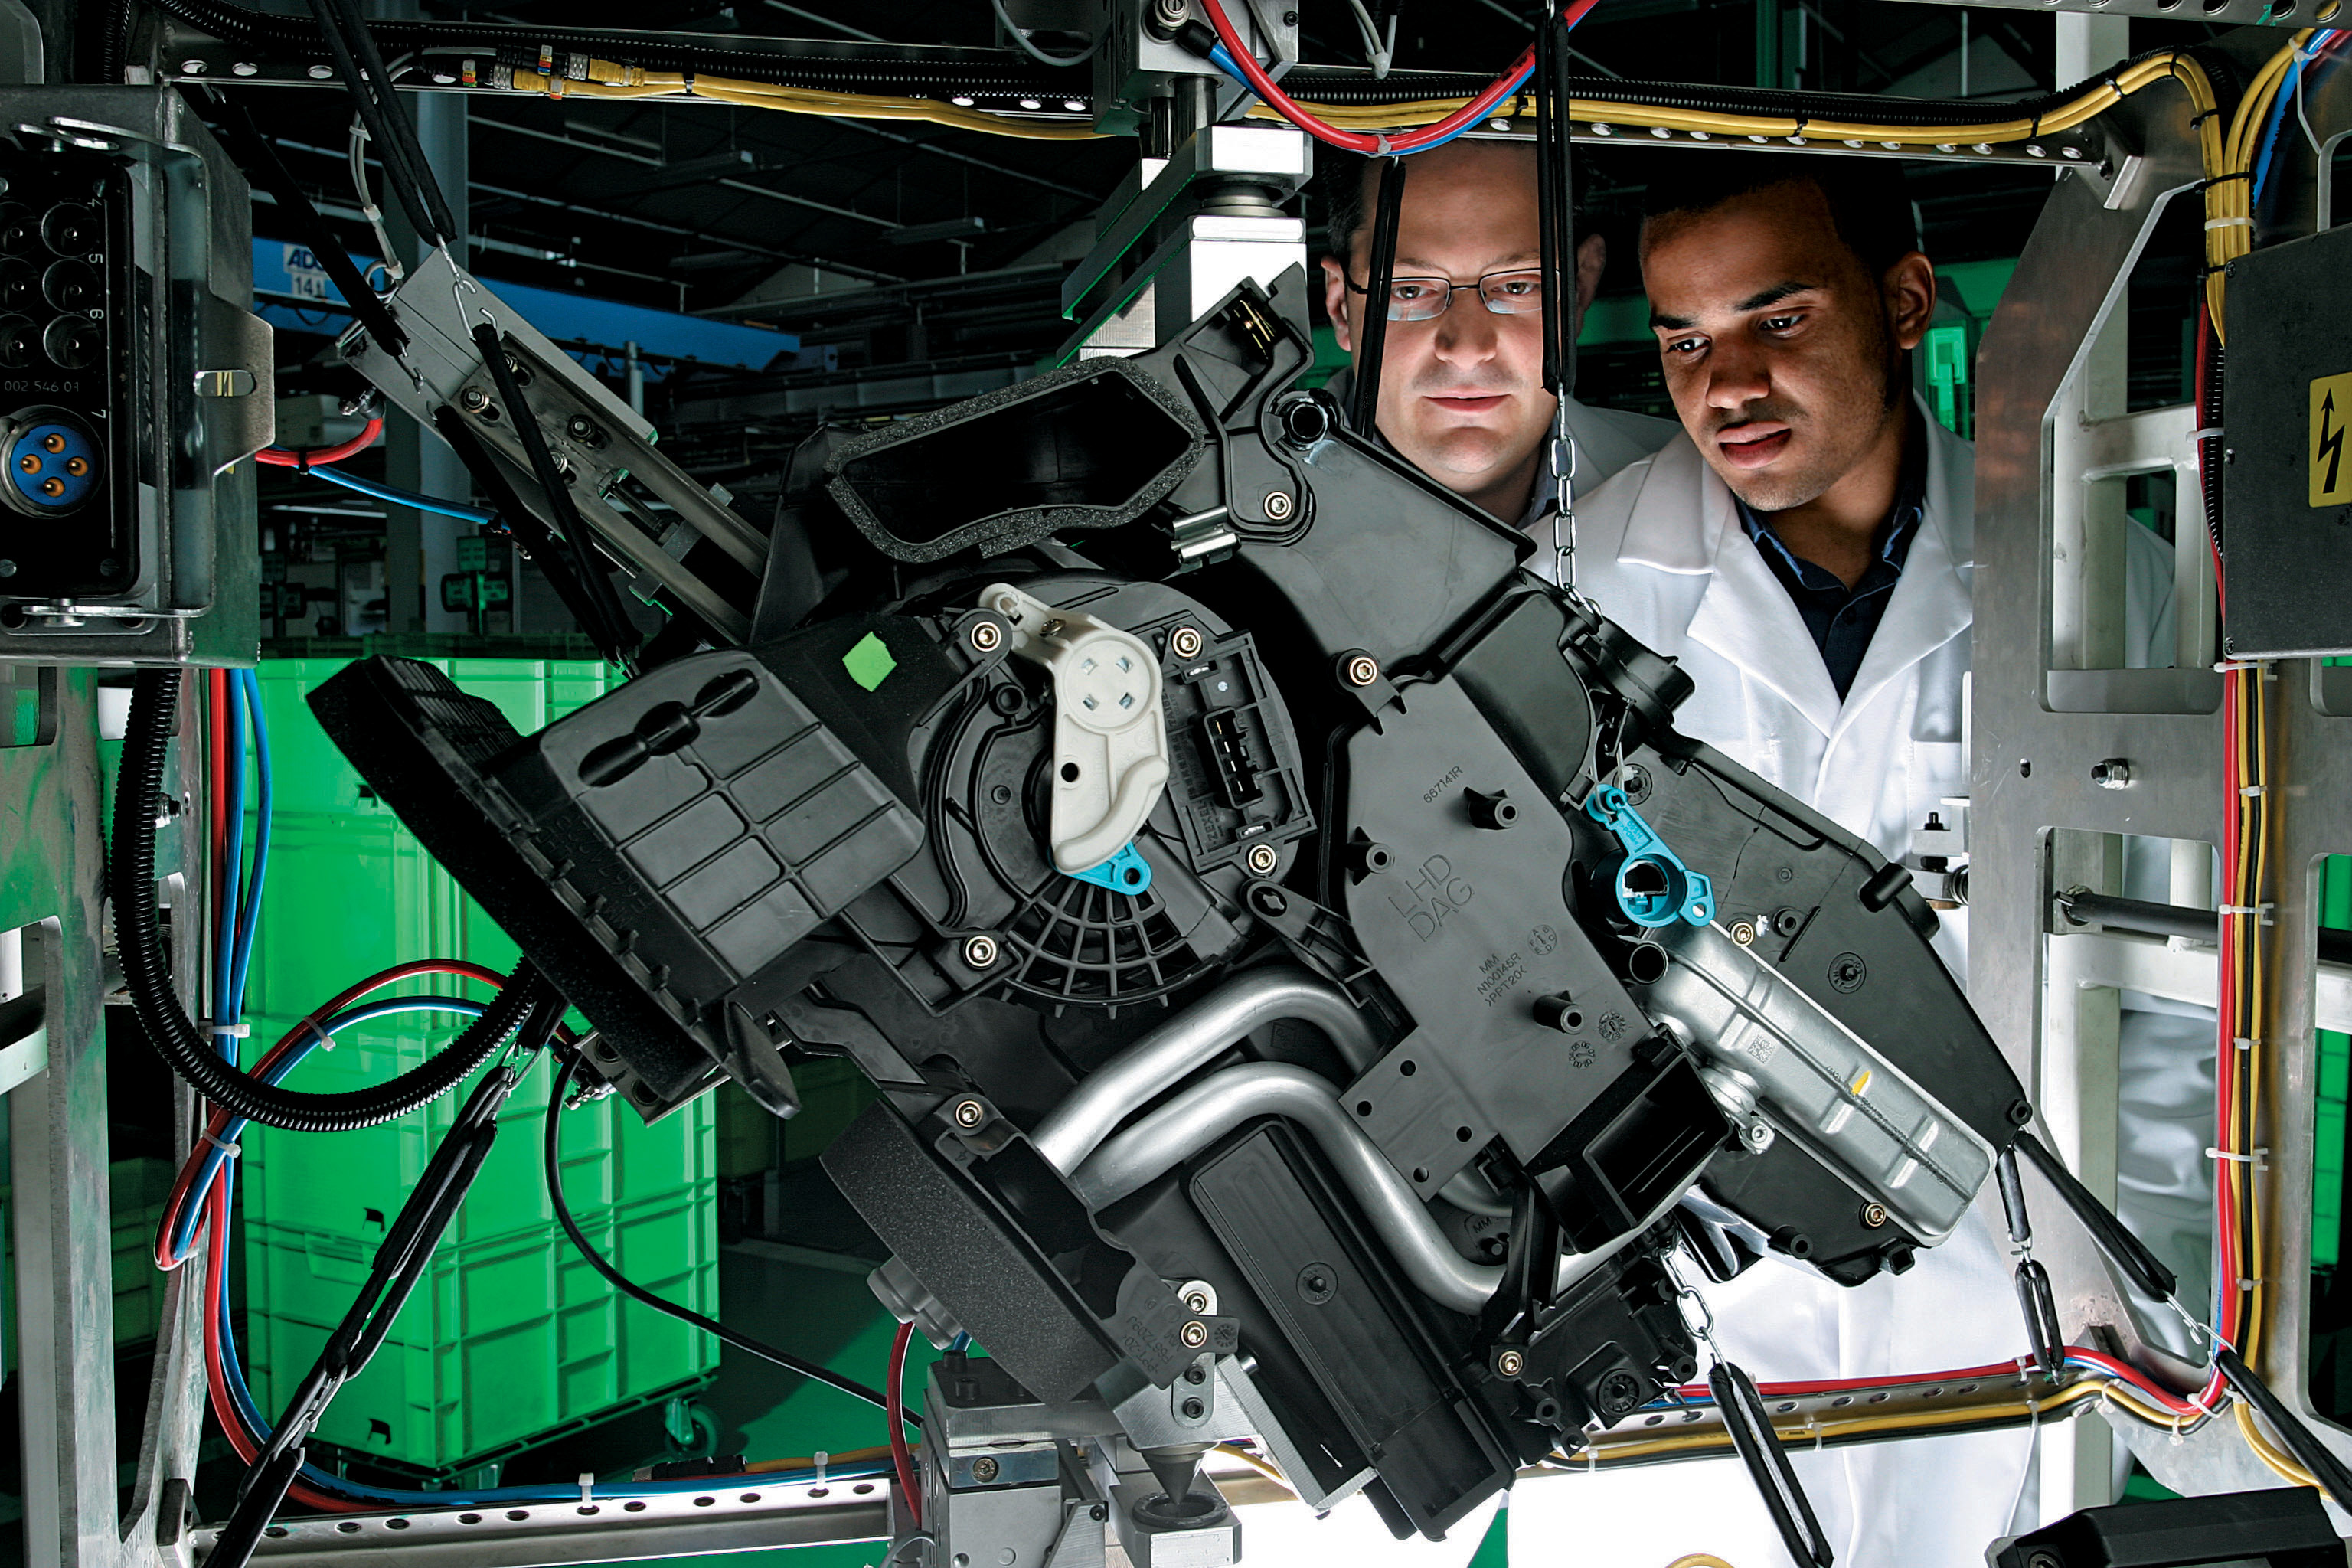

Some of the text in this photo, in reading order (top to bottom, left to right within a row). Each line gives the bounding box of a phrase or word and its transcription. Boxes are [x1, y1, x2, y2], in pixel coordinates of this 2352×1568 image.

[87, 198, 102, 207] 4
[88, 253, 103, 263] 5
[90, 309, 104, 319] 6
[4, 381, 28, 392] 002
[34, 381, 59, 392] 546
[92, 409, 106, 419] 7
[1423, 766, 1464, 804] 667141R
[1197, 799, 1219, 841] ZEXEL
[1388, 854, 1451, 919] LHD
[1407, 877, 1473, 942] DAG
[1476, 952, 1522, 995] N100145R
[1478, 952, 1500, 975] MM
[1472, 1216, 1493, 1234] MM
[1126, 1315, 1174, 1364] F667209J
